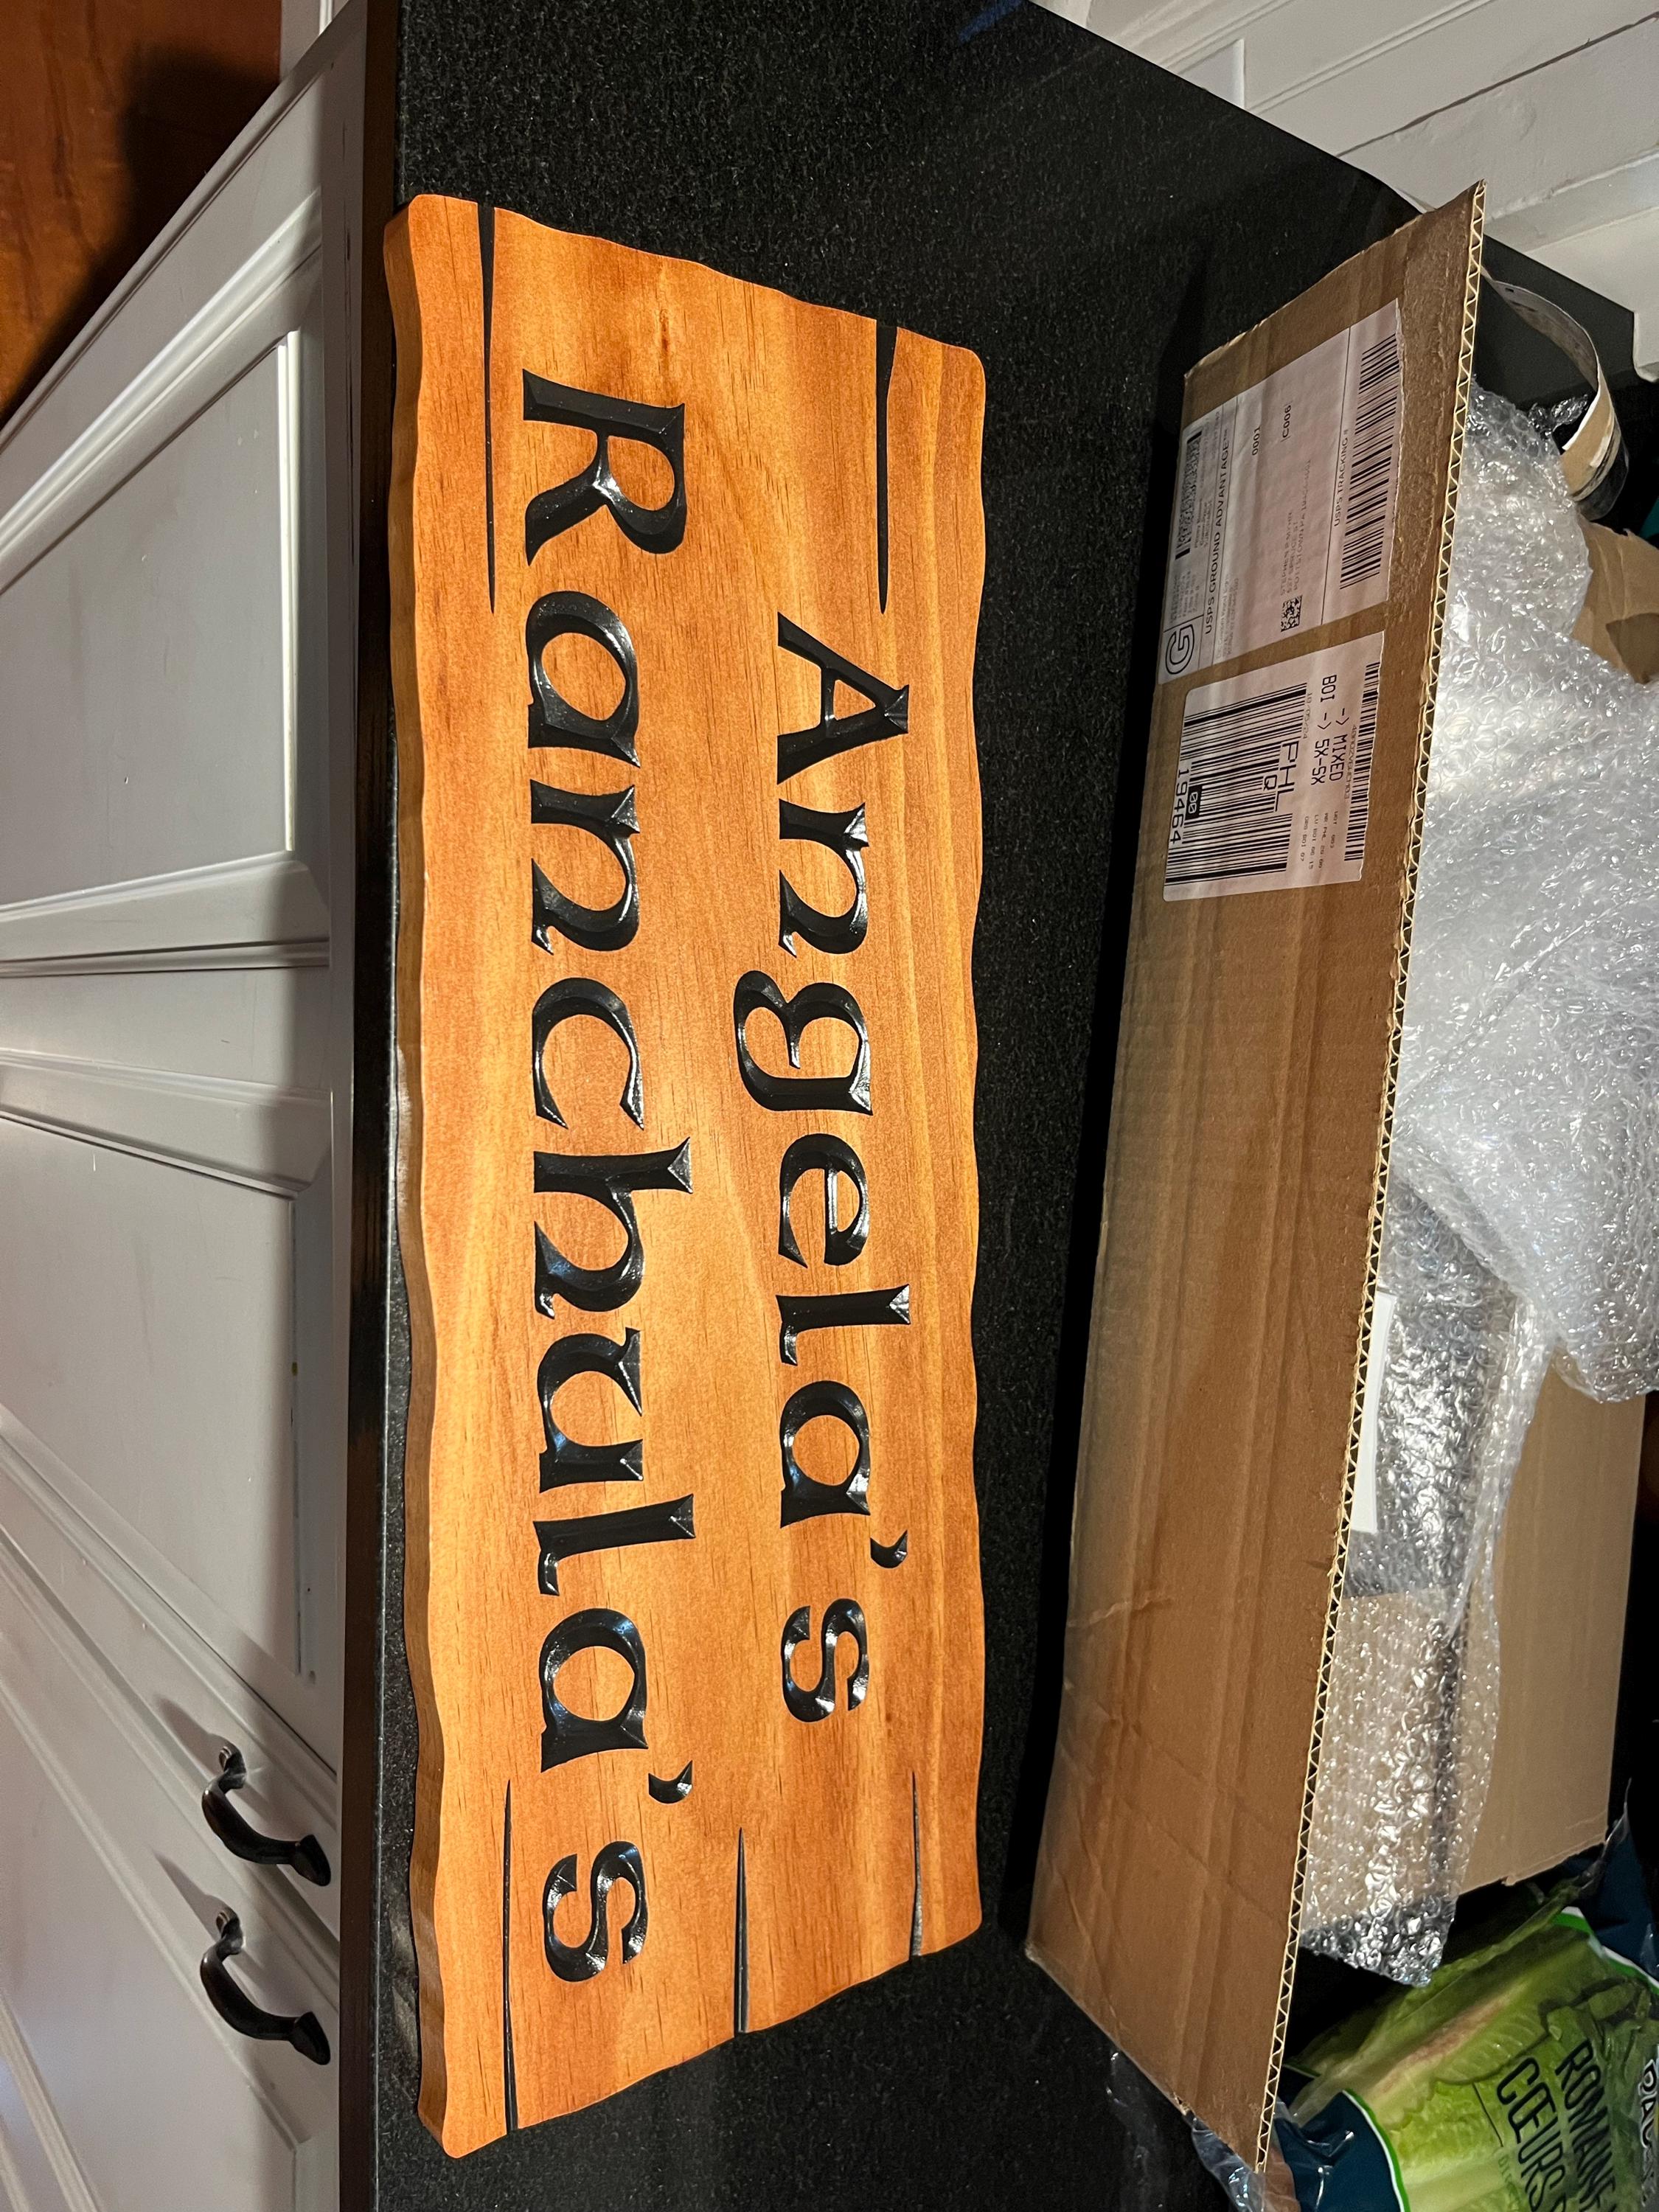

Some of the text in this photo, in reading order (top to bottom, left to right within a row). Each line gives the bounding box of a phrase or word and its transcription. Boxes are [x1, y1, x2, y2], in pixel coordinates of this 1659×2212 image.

[1251, 425, 1261, 456] 0001
[1337, 437, 1349, 495] TRACKING
[1333, 496, 1343, 527] USPS
[1209, 532, 1221, 593] GROUND
[1206, 596, 1215, 634] USPS
[1320, 675, 1338, 703] BOI
[1262, 774, 1278, 791] Q
[1275, 740, 1299, 813] PHL
[1329, 734, 1349, 782] MIXED
[1170, 768, 1189, 844] 19464
[522, 368, 695, 1983] Ranchula's
[734, 611, 911, 1723] Angela's
